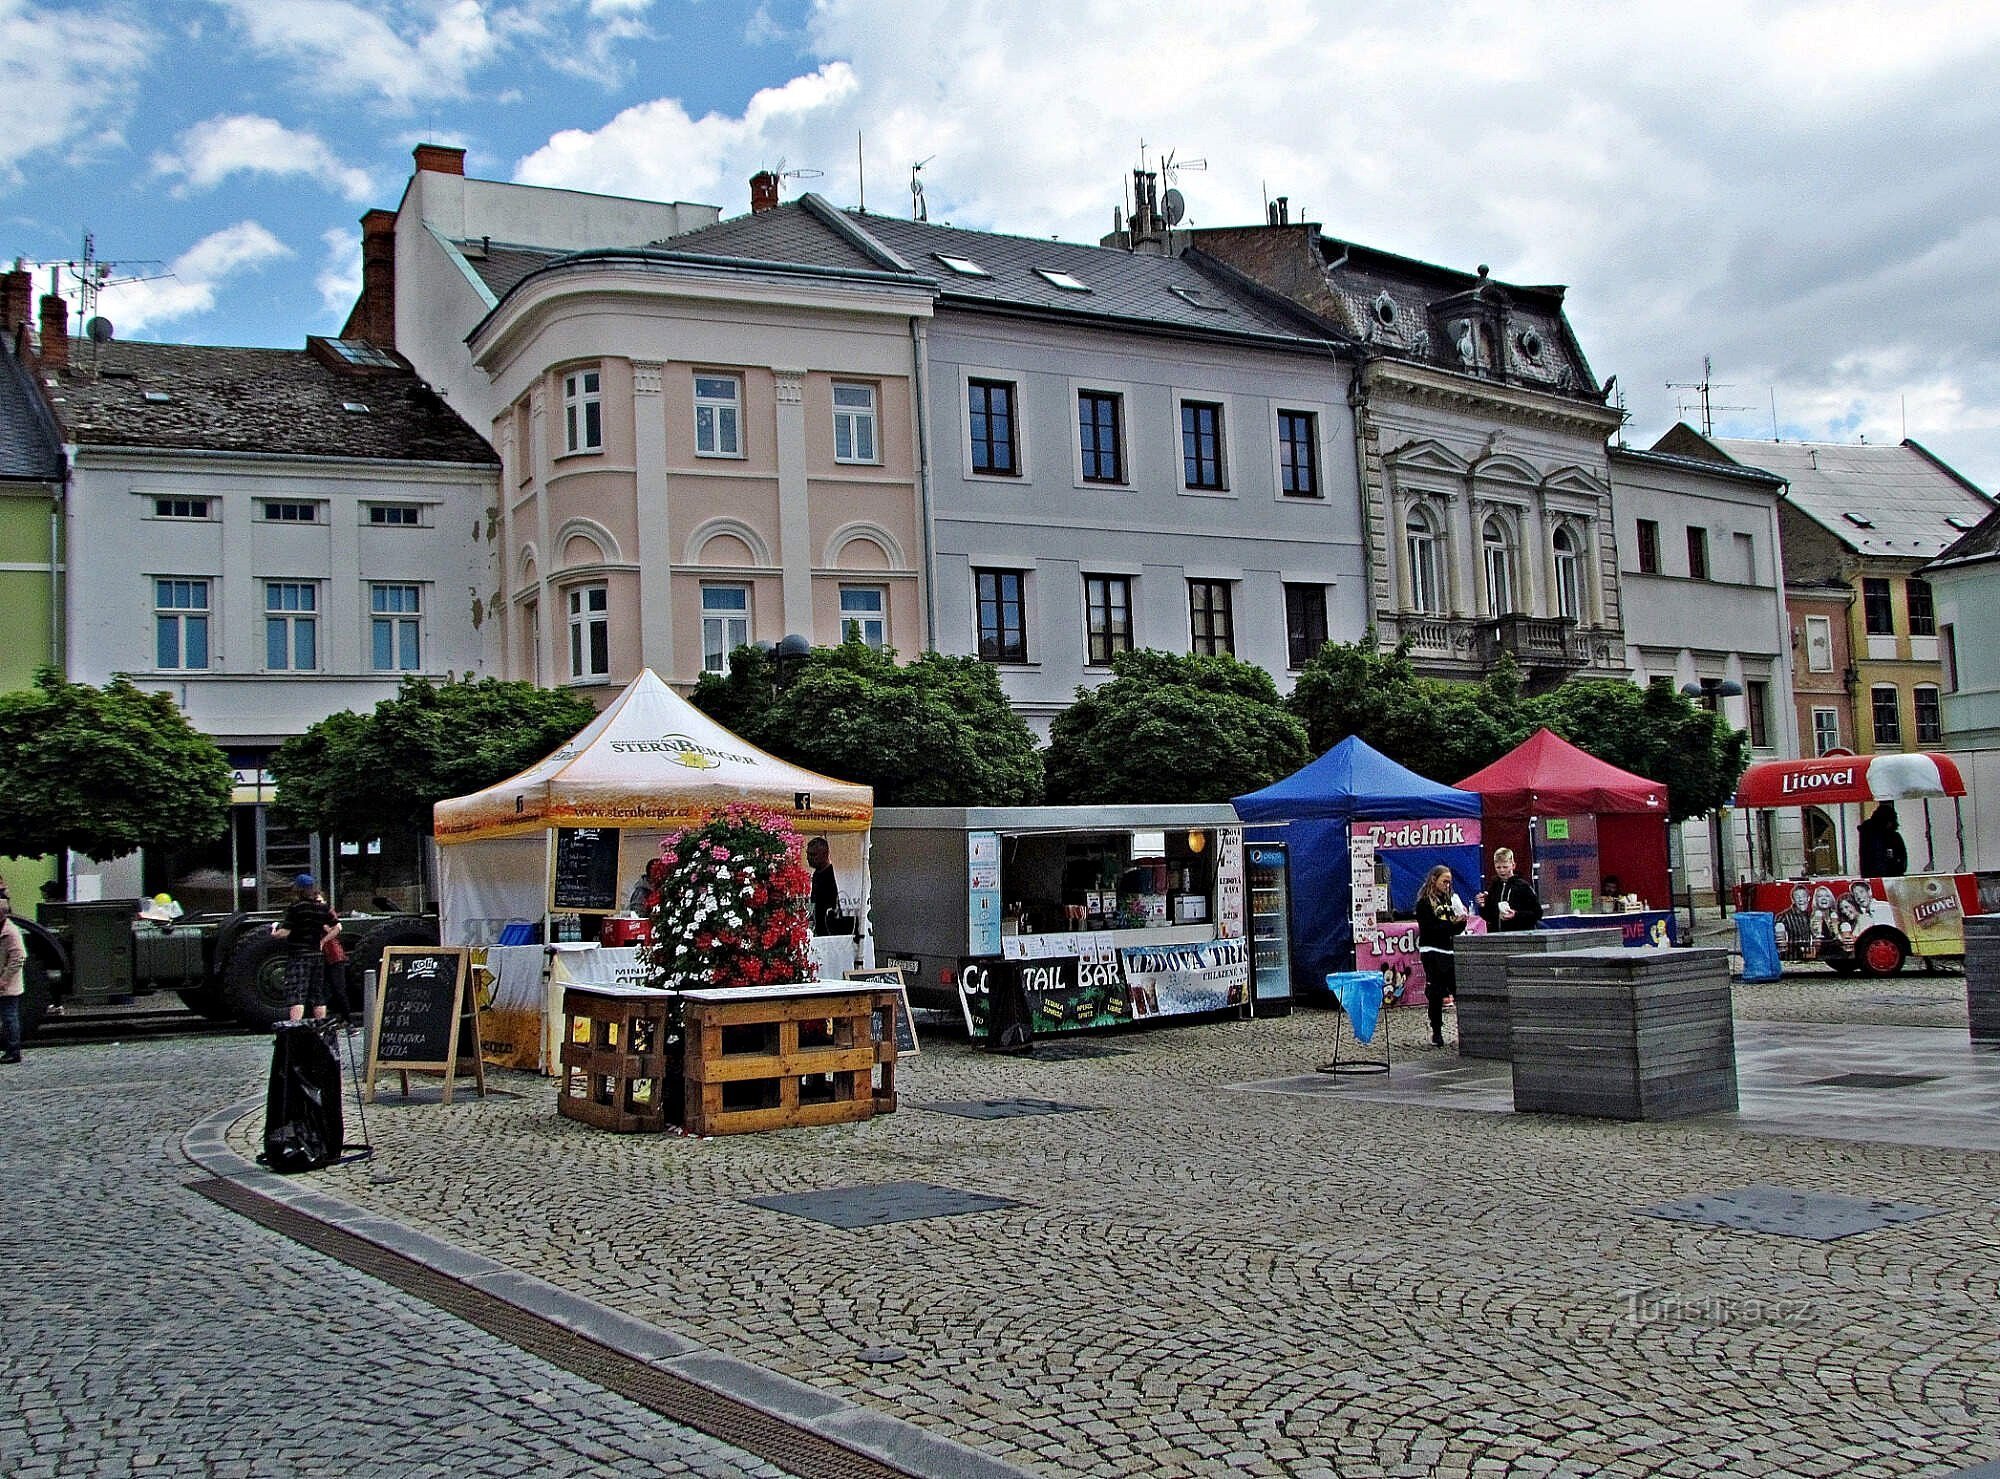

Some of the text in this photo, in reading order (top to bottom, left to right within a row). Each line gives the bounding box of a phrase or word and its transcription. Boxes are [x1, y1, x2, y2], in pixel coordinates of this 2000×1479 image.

[1782, 767, 1854, 793] Litovel
[575, 805, 690, 820] www.sternberger.cz
[1915, 895, 1956, 921] Litovel
[1127, 944, 1206, 974] LEDOVÁ
[962, 963, 1120, 995] COTAIL BAR
